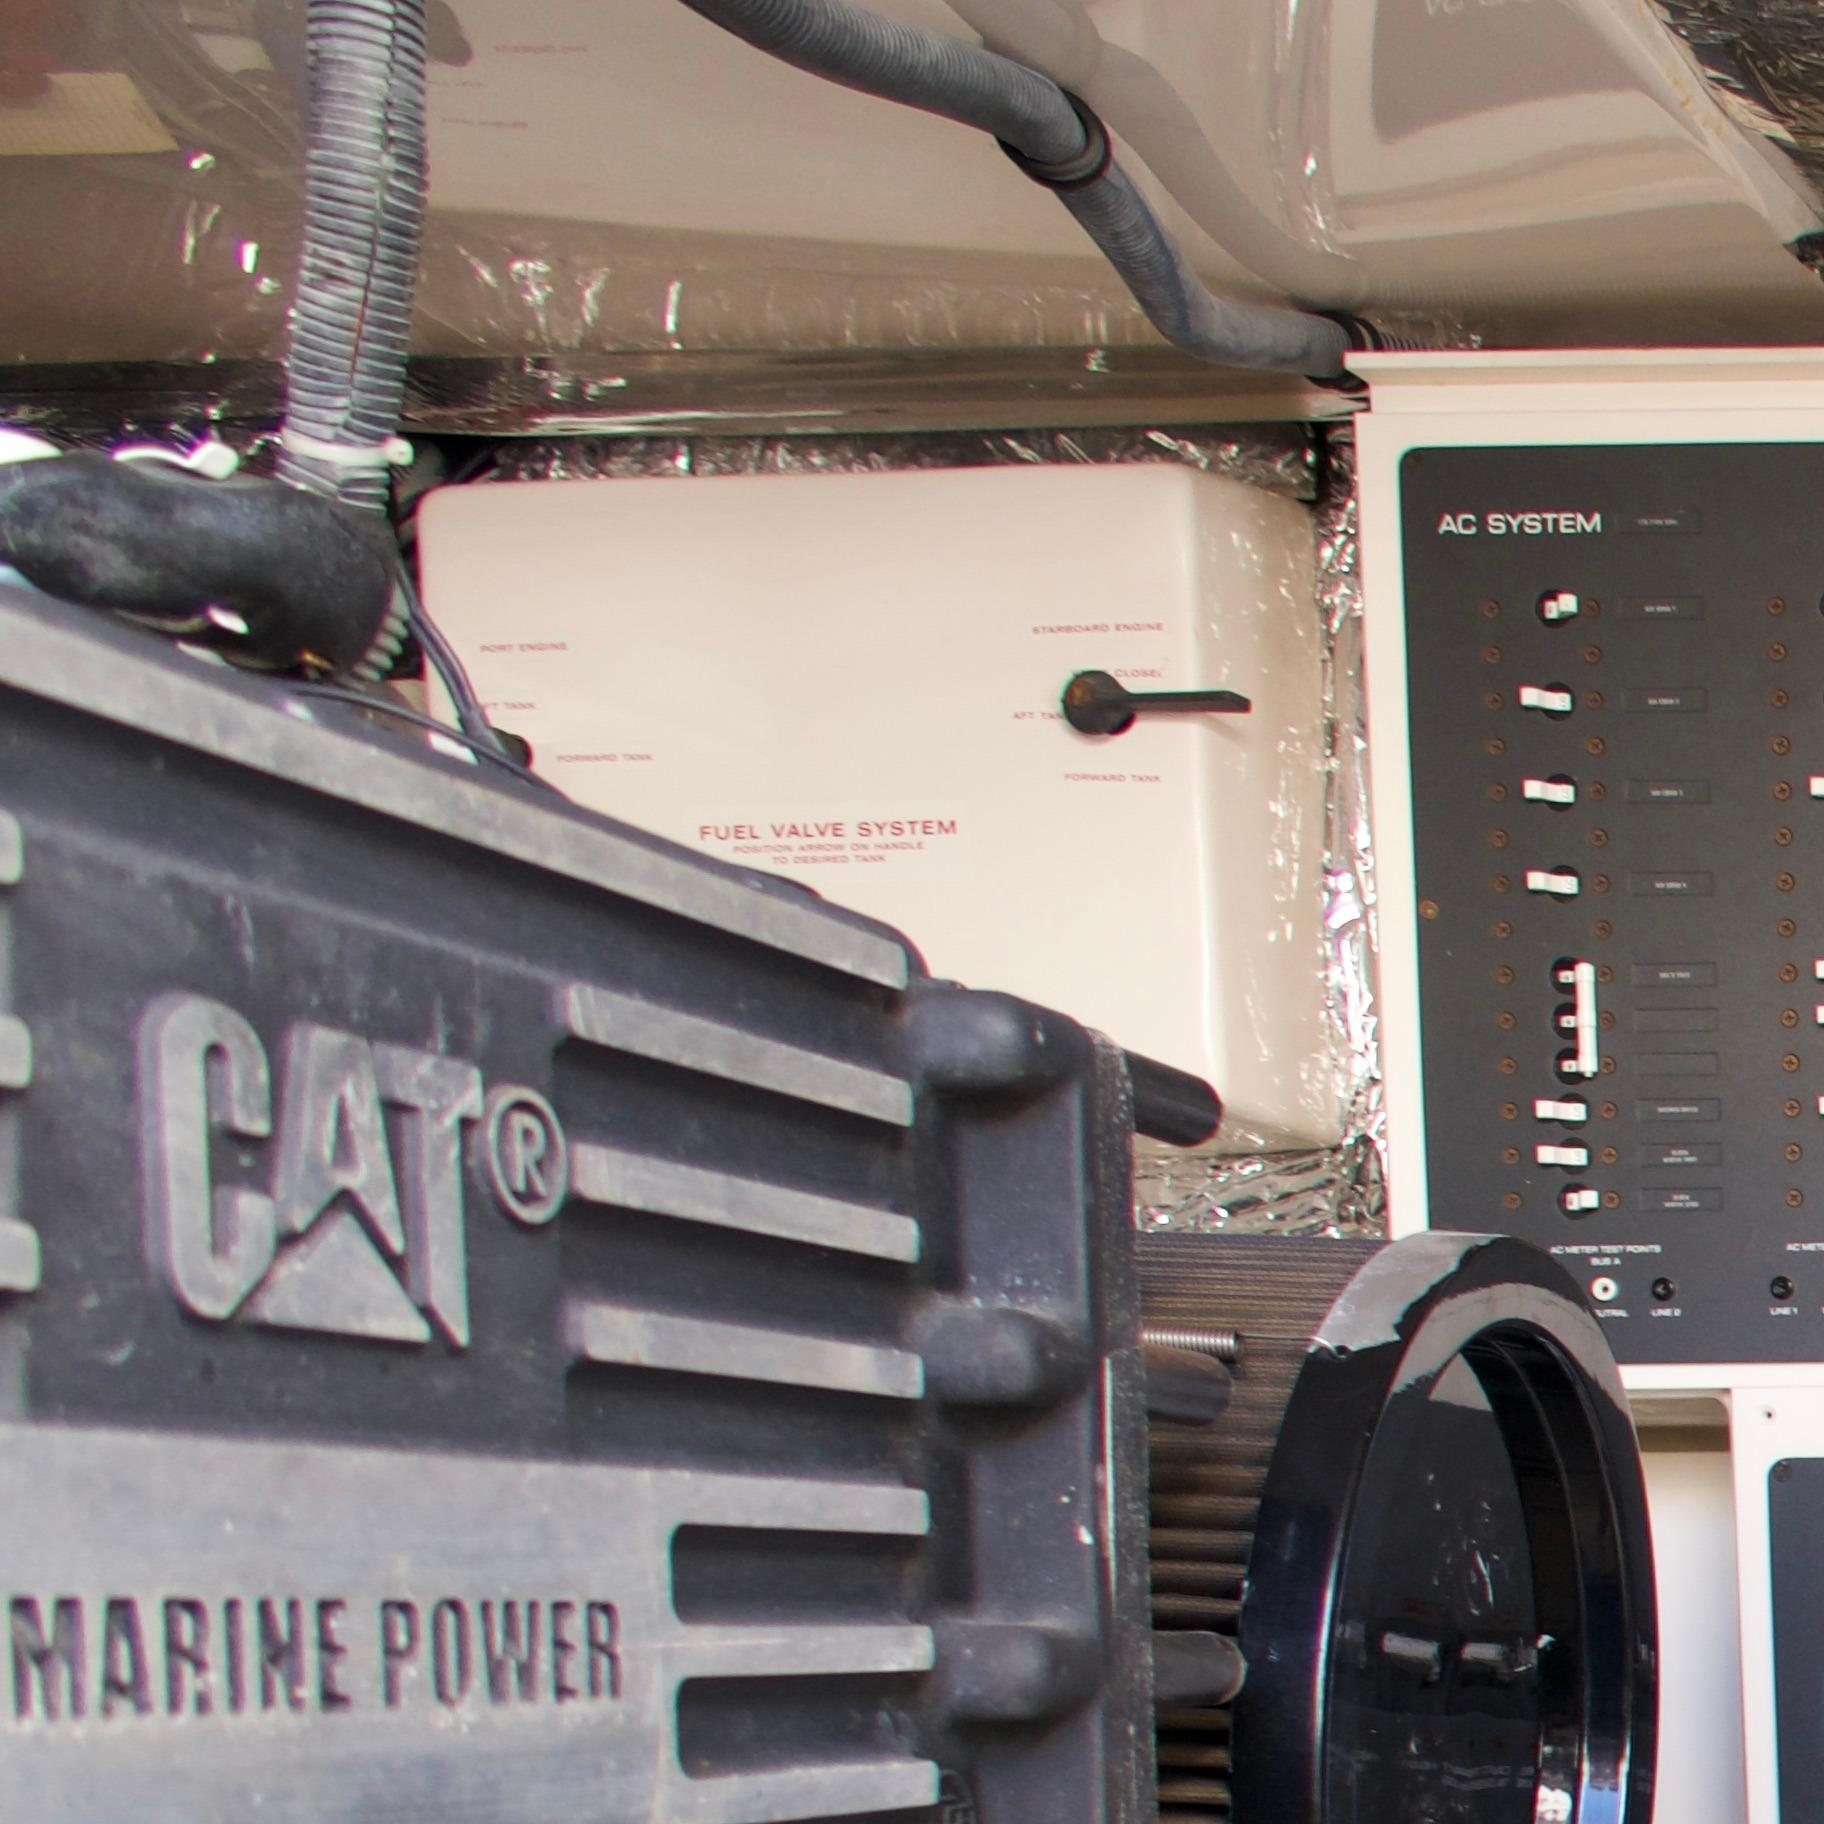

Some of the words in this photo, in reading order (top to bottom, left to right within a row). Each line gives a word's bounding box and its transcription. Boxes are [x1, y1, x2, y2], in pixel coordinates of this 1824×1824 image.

[1438, 513, 1478, 535] AC
[1487, 512, 1603, 534] SYSTEM
[480, 643, 513, 655] PORT
[519, 641, 568, 653] ENGINE
[699, 823, 760, 843] FUEL
[770, 821, 846, 840] VALVE
[855, 818, 958, 838] SYSTEM
[873, 841, 925, 852] HANDLE
[853, 853, 887, 864] TANK
[1565, 1245, 1599, 1254] METER
[1600, 1245, 1623, 1253] TEST
[1624, 1244, 1662, 1253] POINTS
[1786, 1242, 1800, 1251] AC
[1590, 1257, 1612, 1266] BUS
[8, 1592, 350, 1720] MARINE
[380, 1597, 625, 1710] POWER
